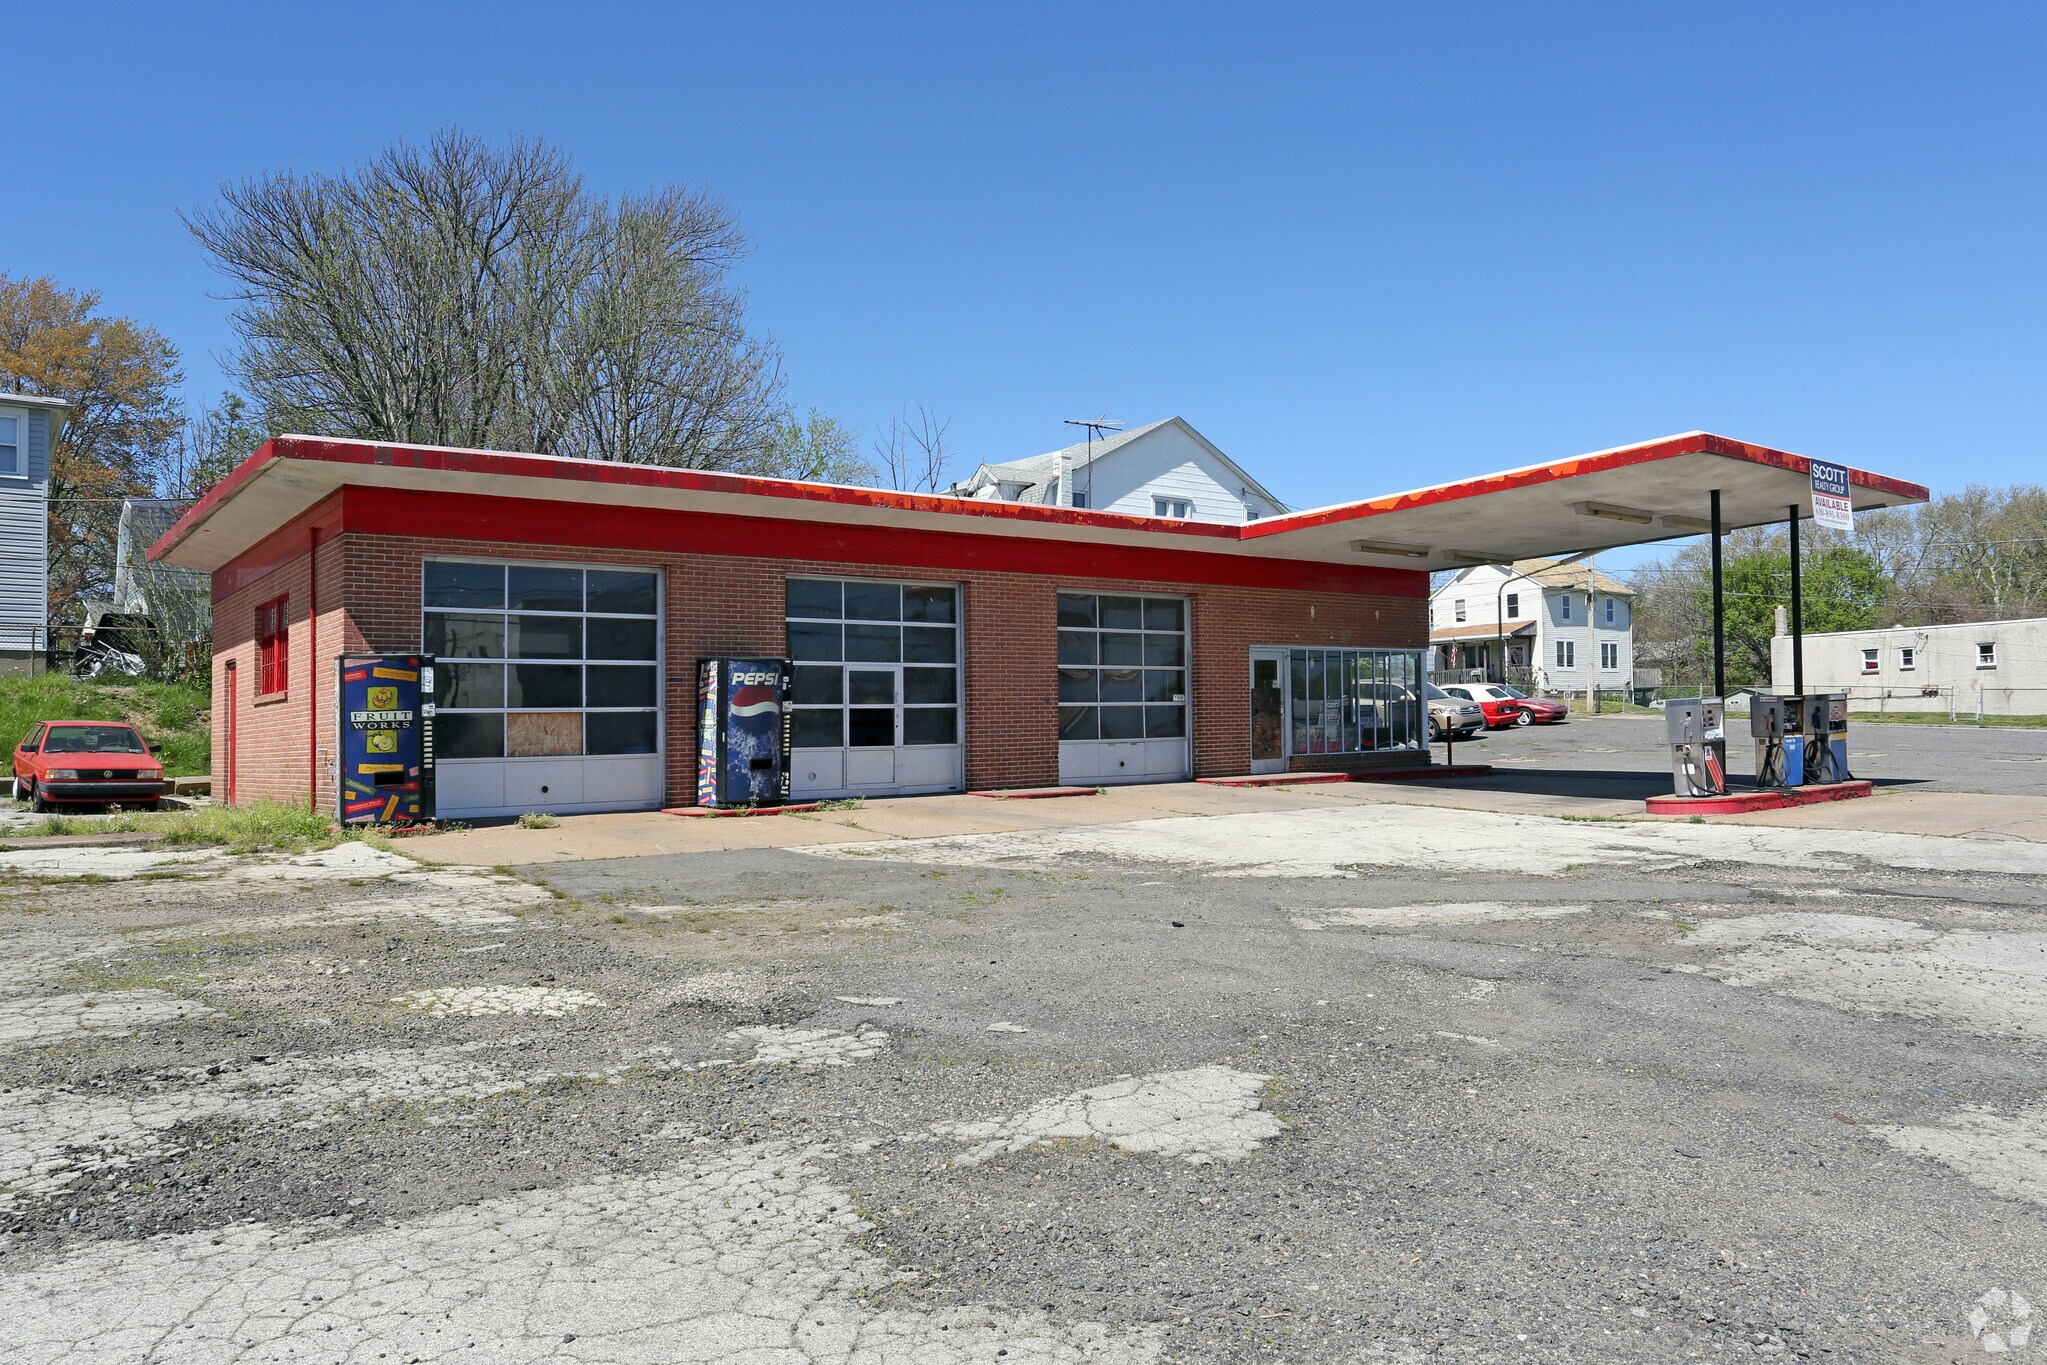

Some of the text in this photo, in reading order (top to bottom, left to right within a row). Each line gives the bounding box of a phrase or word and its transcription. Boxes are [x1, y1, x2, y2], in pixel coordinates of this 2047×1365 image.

[1813, 464, 1845, 483] SCOTT
[1814, 480, 1845, 494] REALTY GROUP
[1815, 496, 1849, 512] AVAILABLE
[731, 672, 779, 686] PEPSI
[353, 712, 411, 721] FRUIT
[353, 721, 411, 730] WORKS
